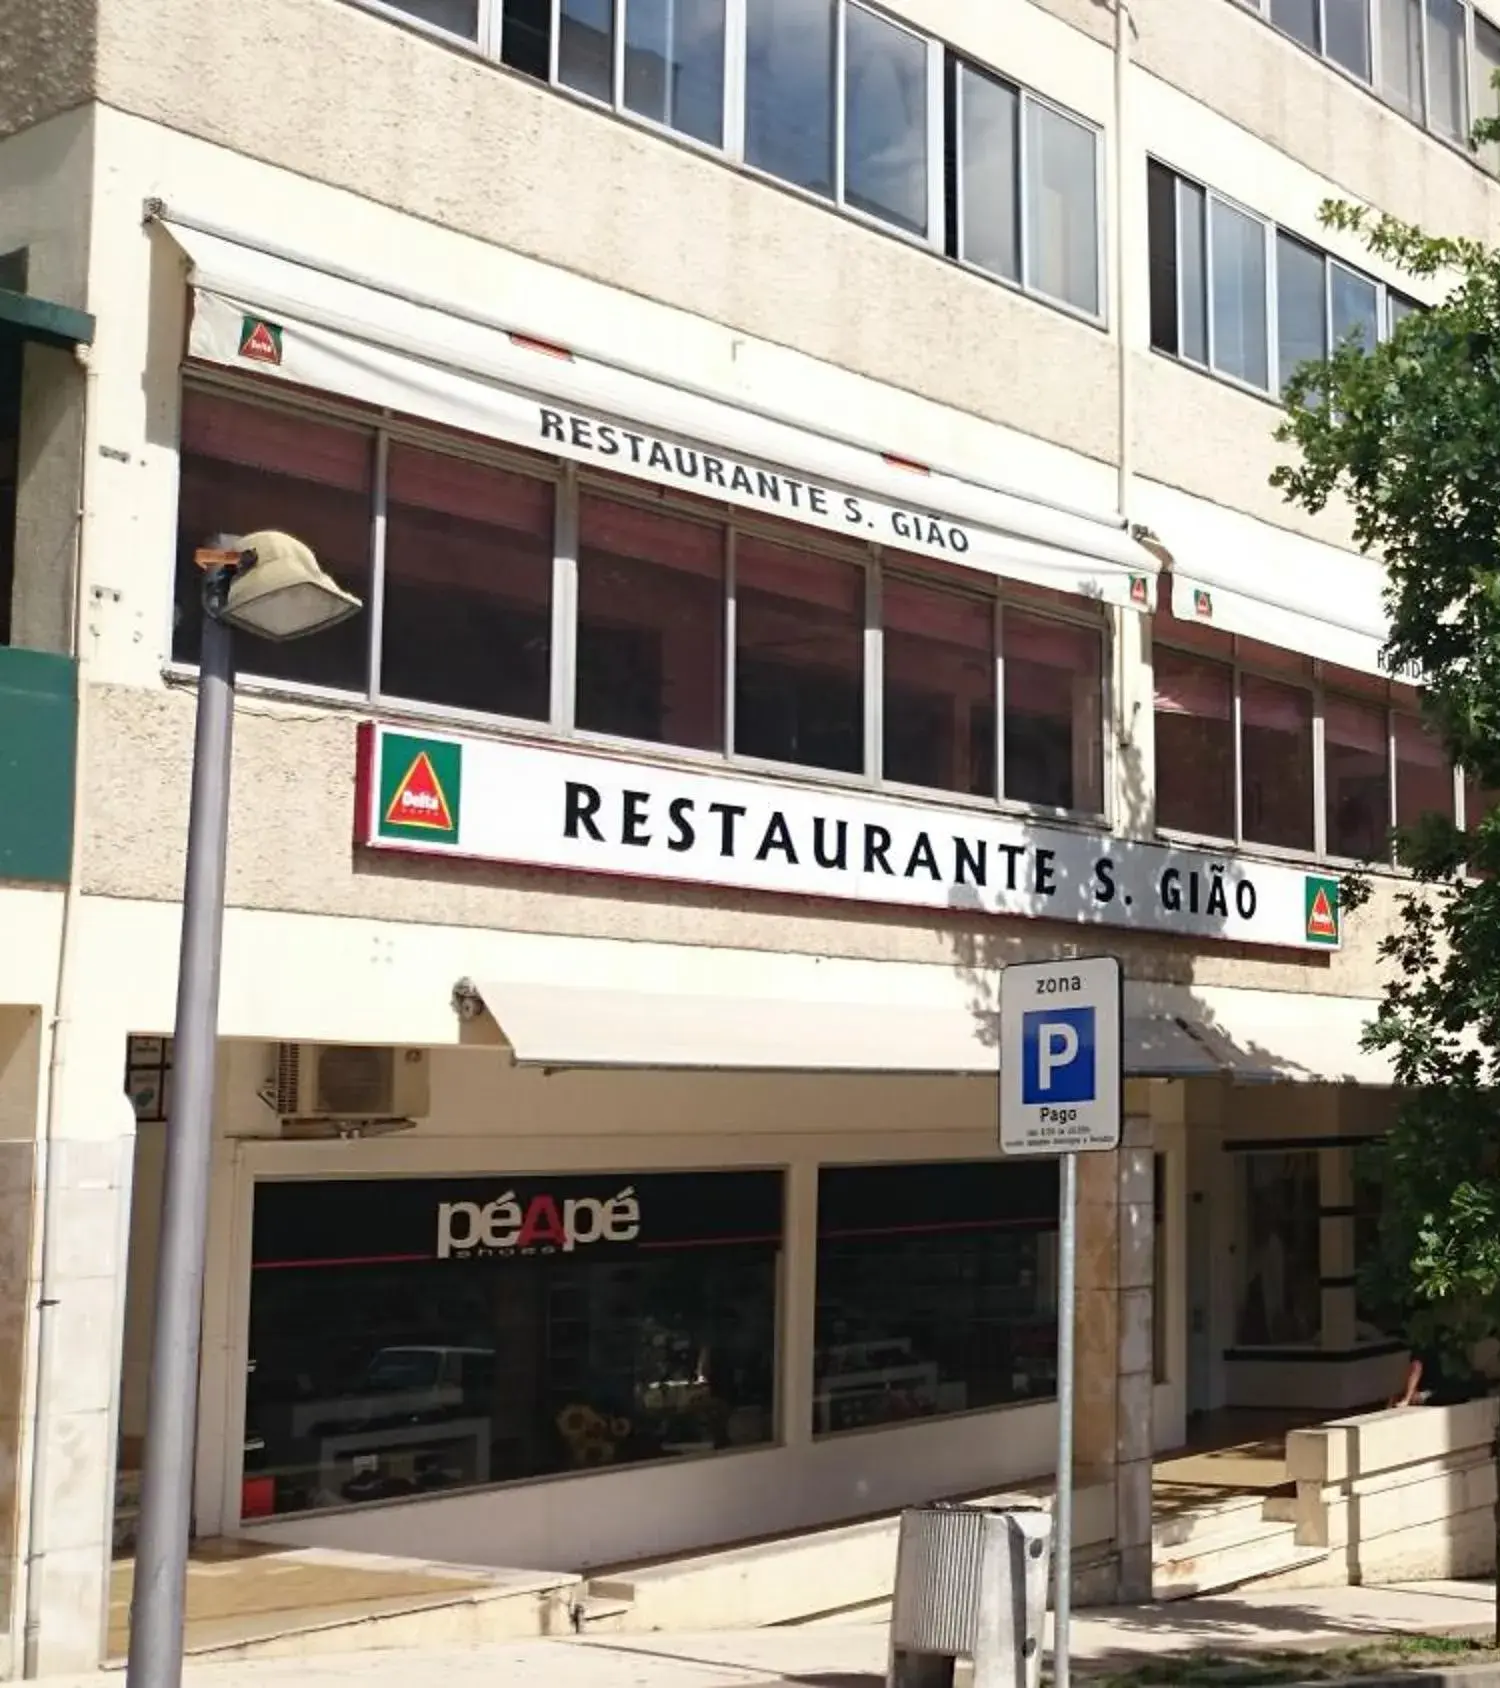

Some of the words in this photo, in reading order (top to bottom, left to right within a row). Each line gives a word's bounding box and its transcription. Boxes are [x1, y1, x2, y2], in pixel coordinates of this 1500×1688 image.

[539, 408, 829, 515] RESTAURANTE
[844, 497, 874, 527] S.
[891, 512, 969, 552] GIÃO
[564, 781, 1057, 896] RESTAURANTE
[1095, 858, 1134, 905] S.
[1160, 865, 1257, 919] GIÃO
[1036, 975, 1081, 994] zona
[1039, 1023, 1079, 1090] P
[1039, 1107, 1077, 1124] Pago
[437, 1186, 640, 1259] péApé
